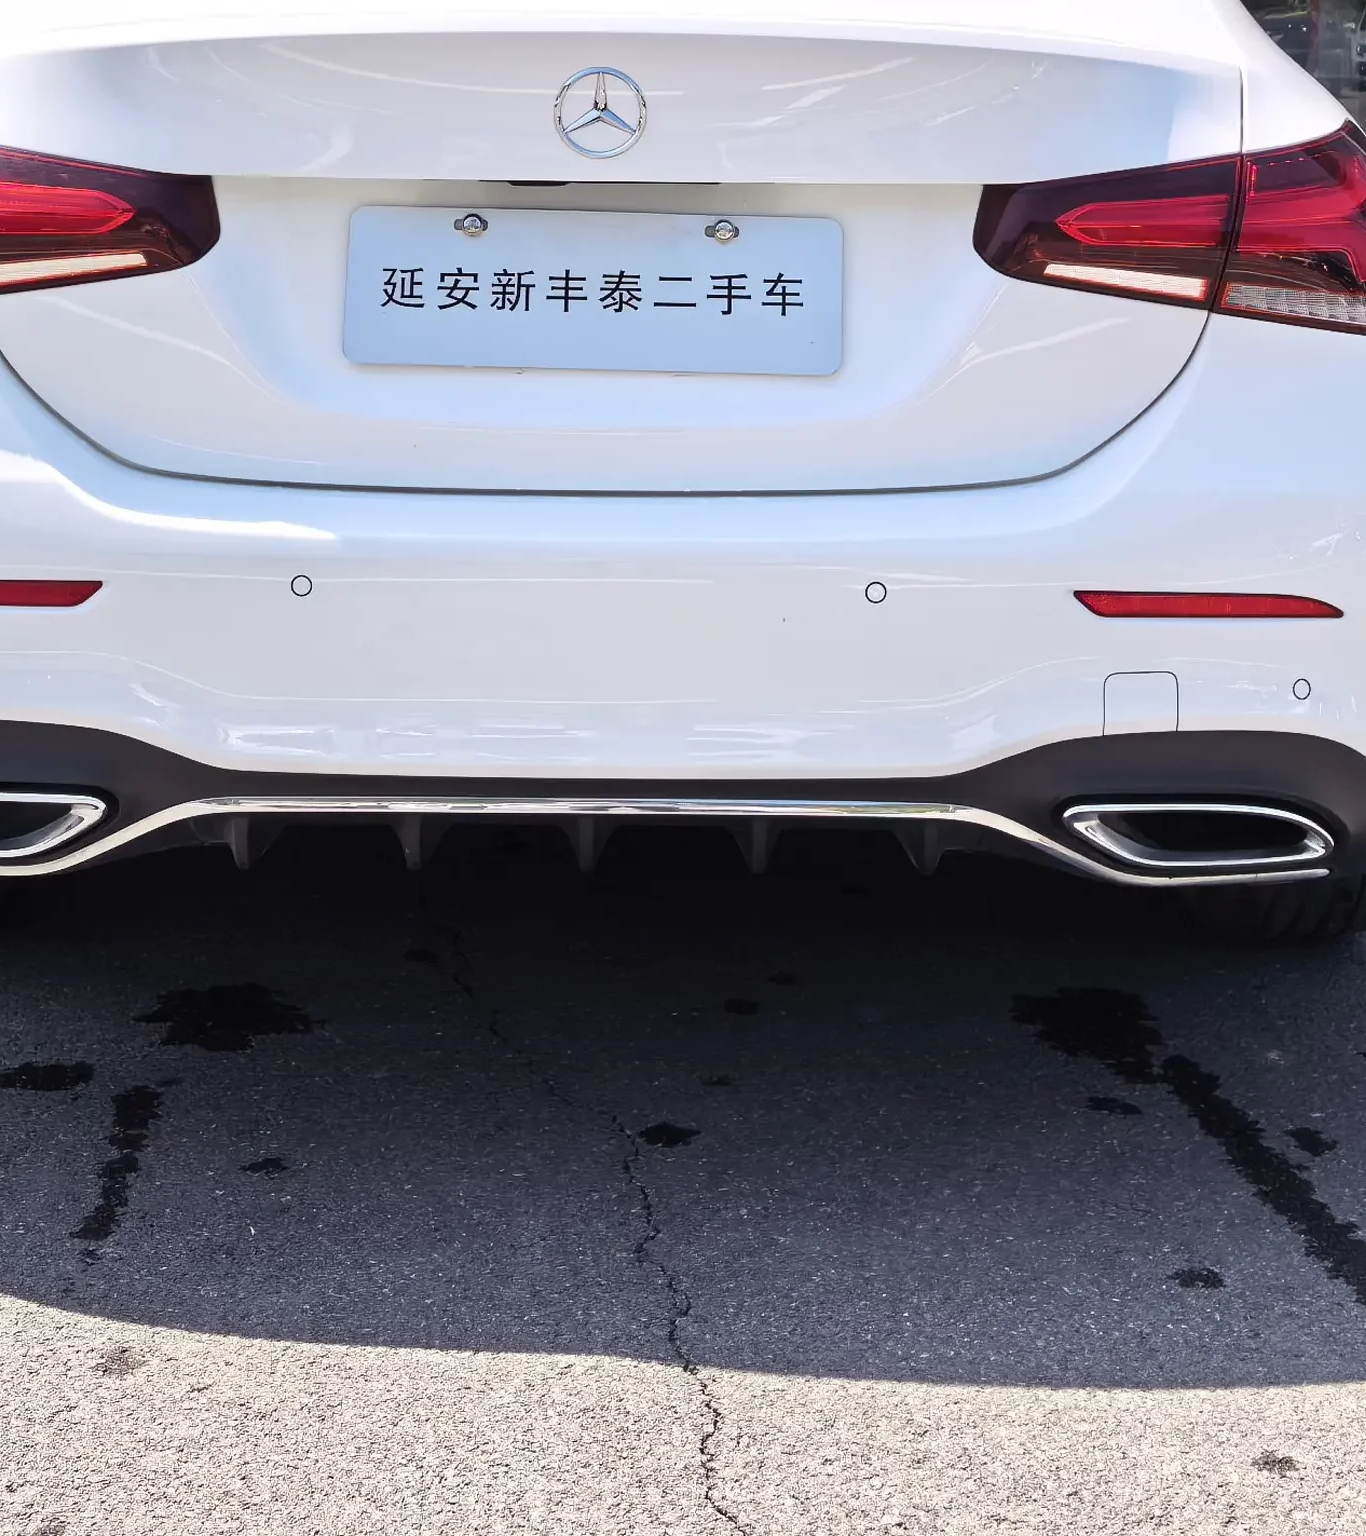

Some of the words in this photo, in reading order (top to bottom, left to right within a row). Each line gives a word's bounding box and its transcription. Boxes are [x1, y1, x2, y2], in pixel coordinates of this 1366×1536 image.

[380, 267, 804, 316] 延安新丰泰二手车
